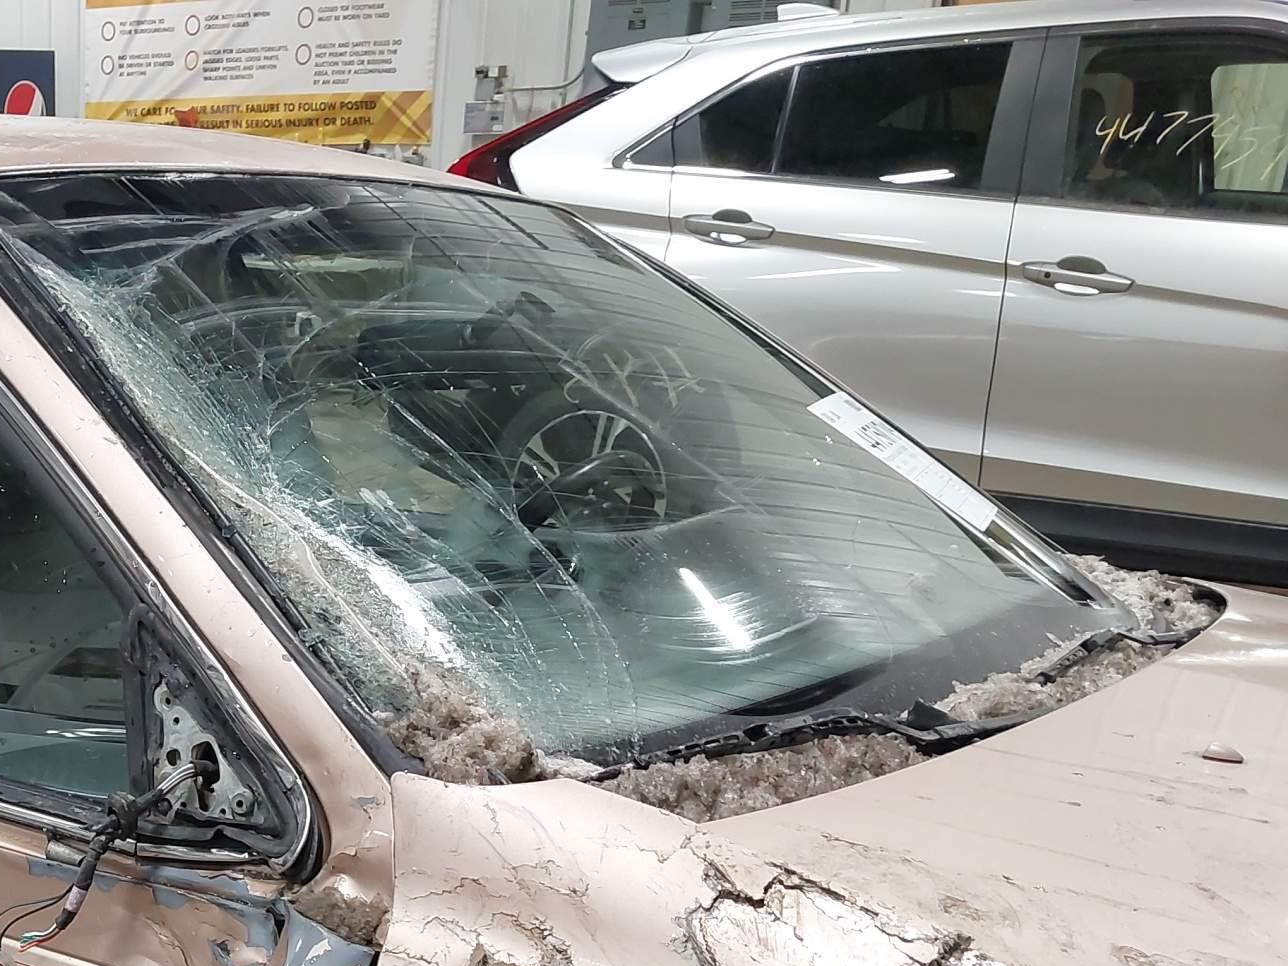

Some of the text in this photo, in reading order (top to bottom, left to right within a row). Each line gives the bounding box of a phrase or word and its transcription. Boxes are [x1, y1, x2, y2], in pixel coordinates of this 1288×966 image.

[140, 107, 161, 115] CARE
[211, 104, 243, 114] SAFETY.
[246, 102, 280, 113] FAILURE
[283, 102, 295, 112] TO
[298, 101, 336, 112] FOLLOW
[340, 100, 376, 110] POSTED
[232, 118, 242, 128] IN
[245, 118, 283, 129] SERIOUS
[286, 118, 320, 127] INJURY
[323, 117, 336, 126] OR
[340, 116, 374, 126] DEATH.
